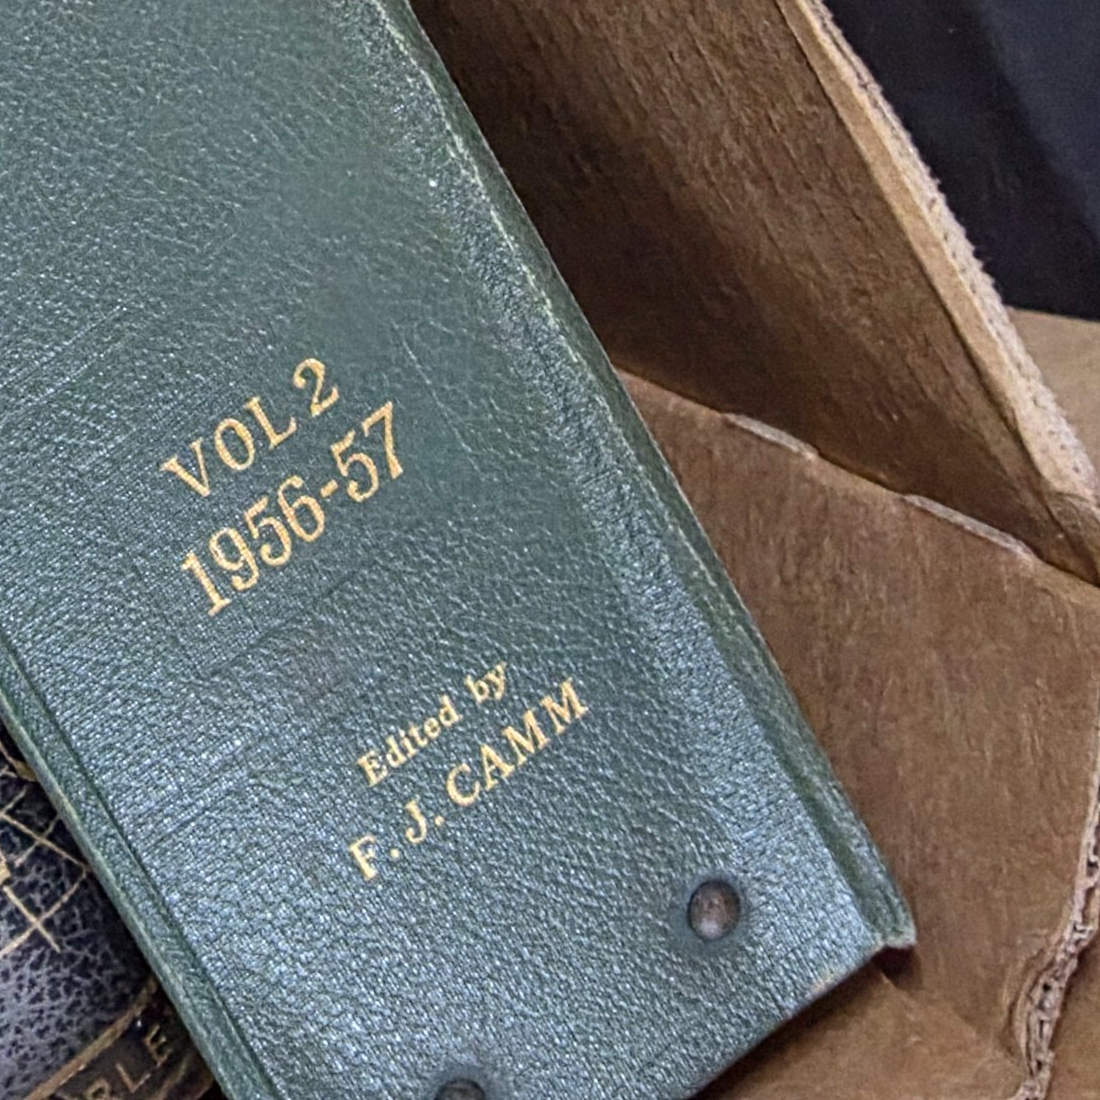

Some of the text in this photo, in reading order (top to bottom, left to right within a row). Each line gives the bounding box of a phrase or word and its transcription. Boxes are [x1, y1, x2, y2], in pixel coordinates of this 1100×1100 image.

[161, 356, 340, 499] VOL 2
[181, 401, 405, 617] 1956-57
[349, 676, 590, 882] F. J. CAMM
[357, 660, 507, 788] Edited by
